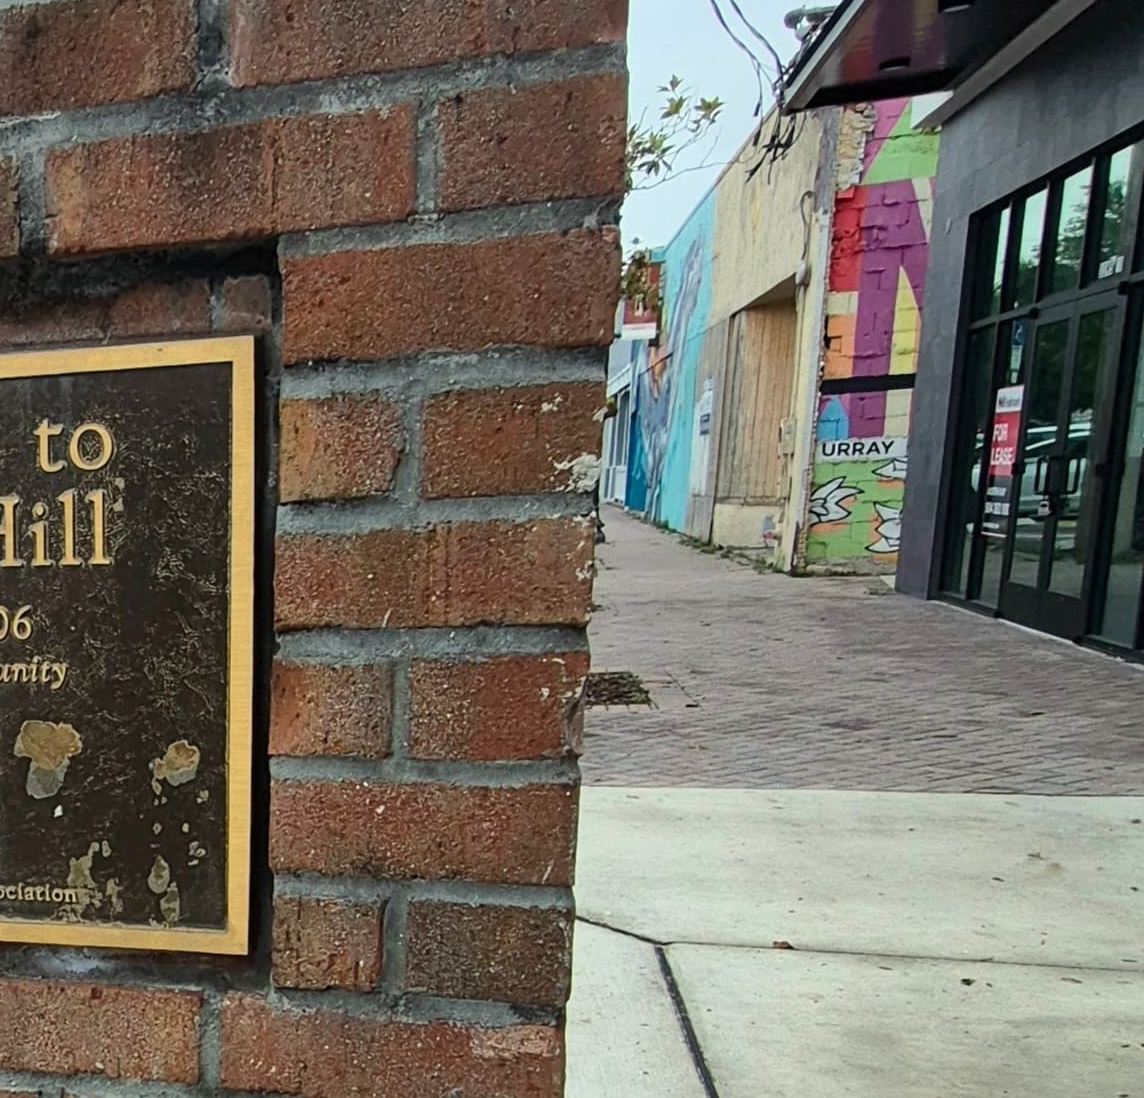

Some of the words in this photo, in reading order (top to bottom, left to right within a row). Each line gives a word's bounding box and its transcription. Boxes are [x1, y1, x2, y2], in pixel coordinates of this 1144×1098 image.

[993, 423, 1008, 442] FOR
[33, 418, 115, 473] to
[822, 441, 895, 456] URRAY
[990, 446, 1016, 465] LEASE
